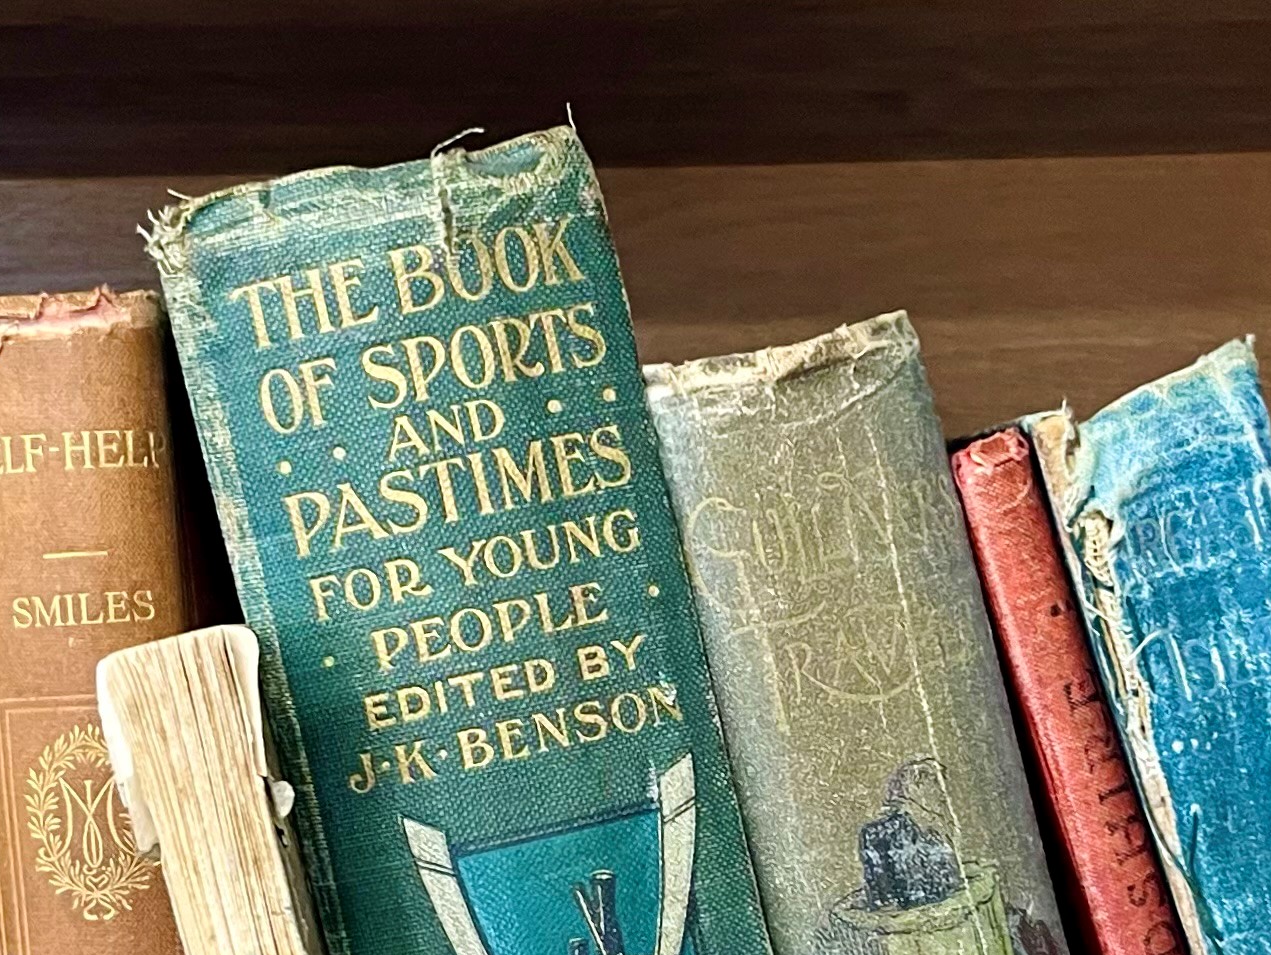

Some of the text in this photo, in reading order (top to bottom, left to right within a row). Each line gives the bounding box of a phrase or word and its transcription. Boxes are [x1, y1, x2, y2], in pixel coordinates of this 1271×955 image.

[229, 214, 585, 350] THE BOOK
[258, 302, 607, 436] OF SPORTS
[388, 399, 505, 461] AND
[282, 424, 633, 560] PASTIMES
[12, 590, 157, 629] SMILES
[308, 509, 641, 621] FOR YOUNG
[370, 582, 610, 672] PEOPLE
[363, 635, 646, 731] EDITED BY
